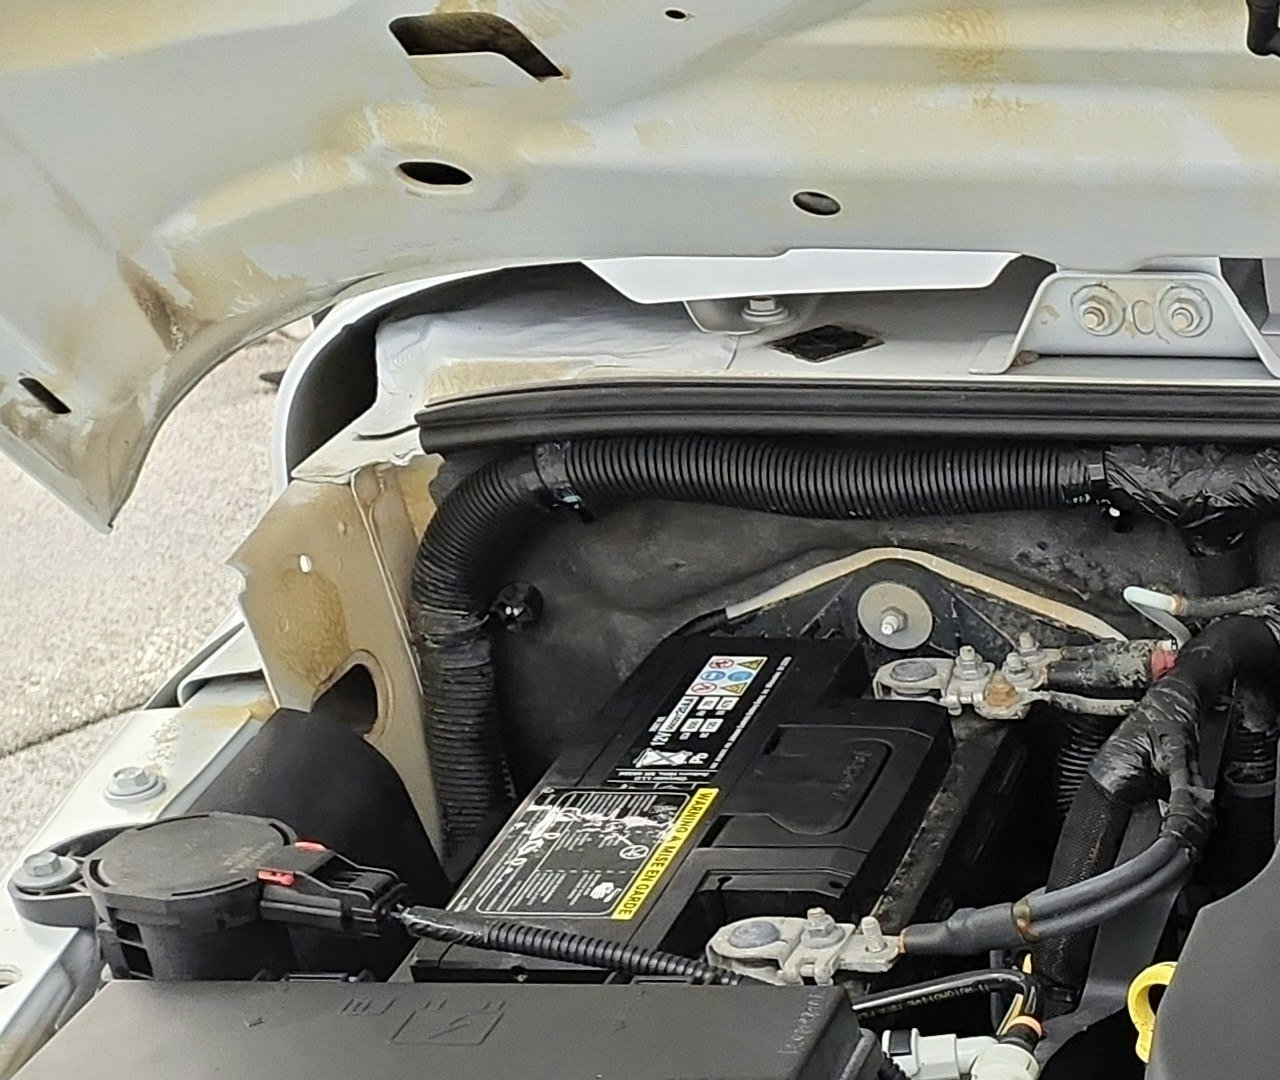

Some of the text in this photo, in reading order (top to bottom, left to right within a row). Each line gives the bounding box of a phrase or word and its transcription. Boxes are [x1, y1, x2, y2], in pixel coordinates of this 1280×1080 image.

[674, 792, 713, 833] WARNING
[618, 845, 677, 916] MISE EN GARDE
